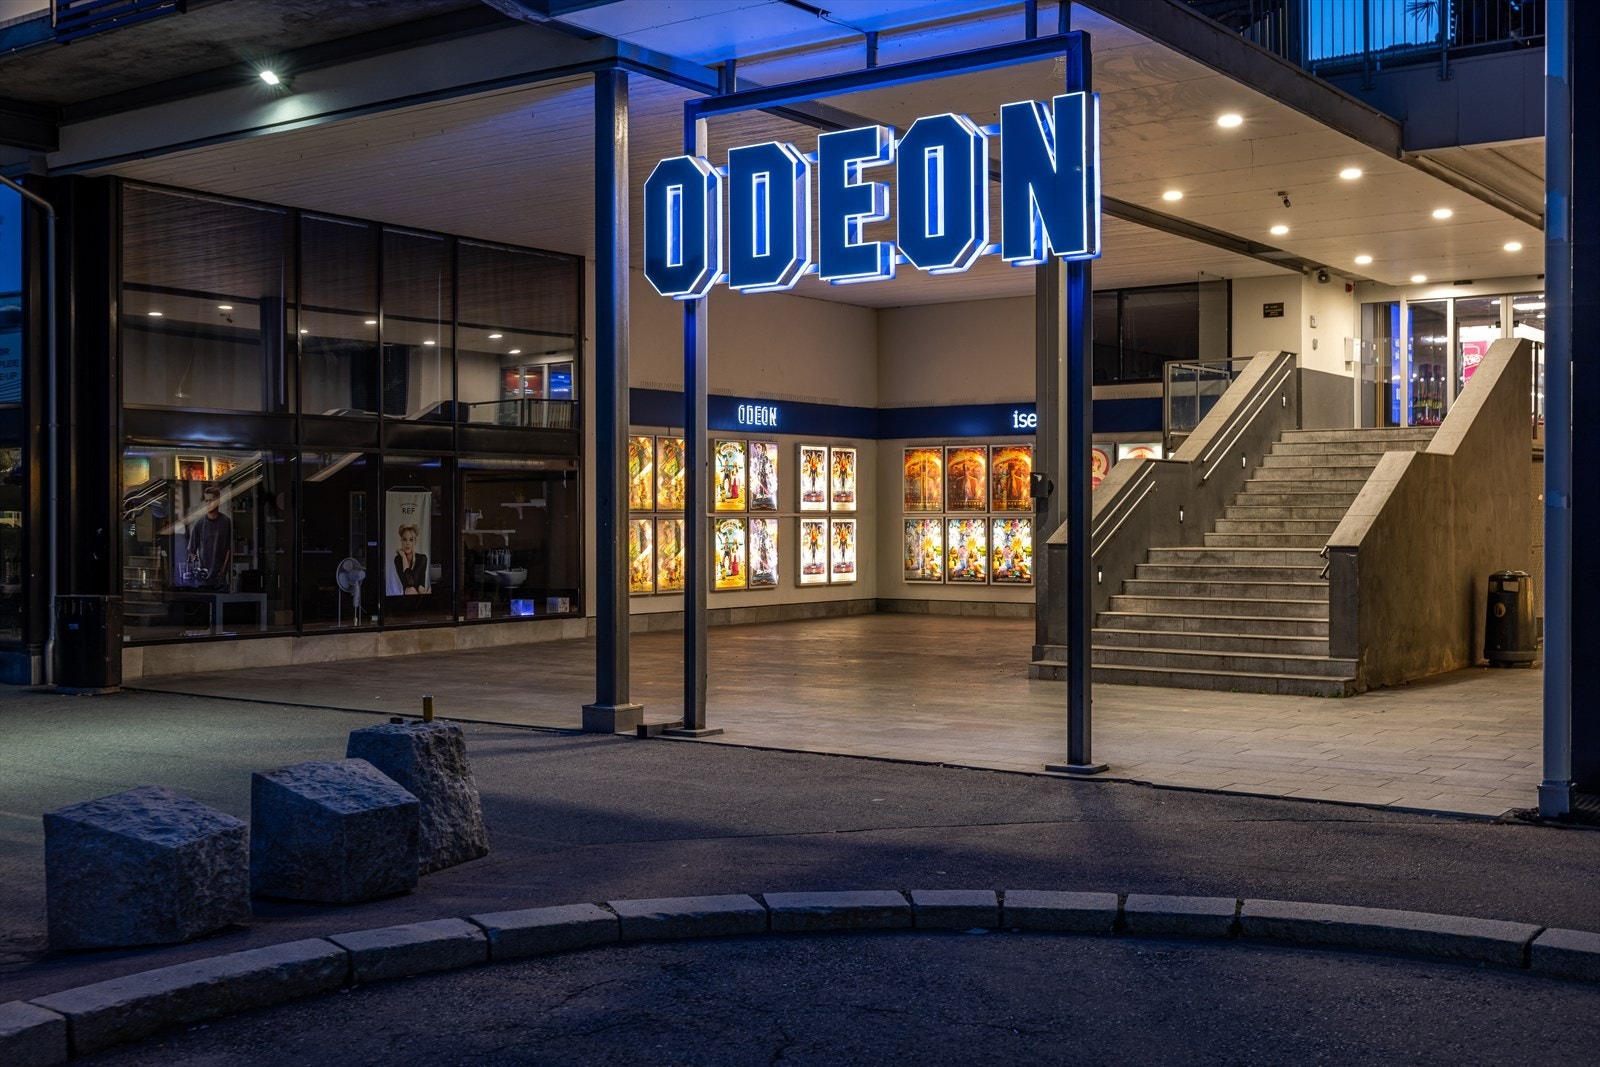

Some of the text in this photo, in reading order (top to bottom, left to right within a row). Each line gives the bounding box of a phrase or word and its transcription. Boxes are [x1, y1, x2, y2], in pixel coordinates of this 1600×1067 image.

[644, 91, 1100, 300] ODEON
[738, 404, 777, 427] ODEON
[402, 507, 416, 515] REF
